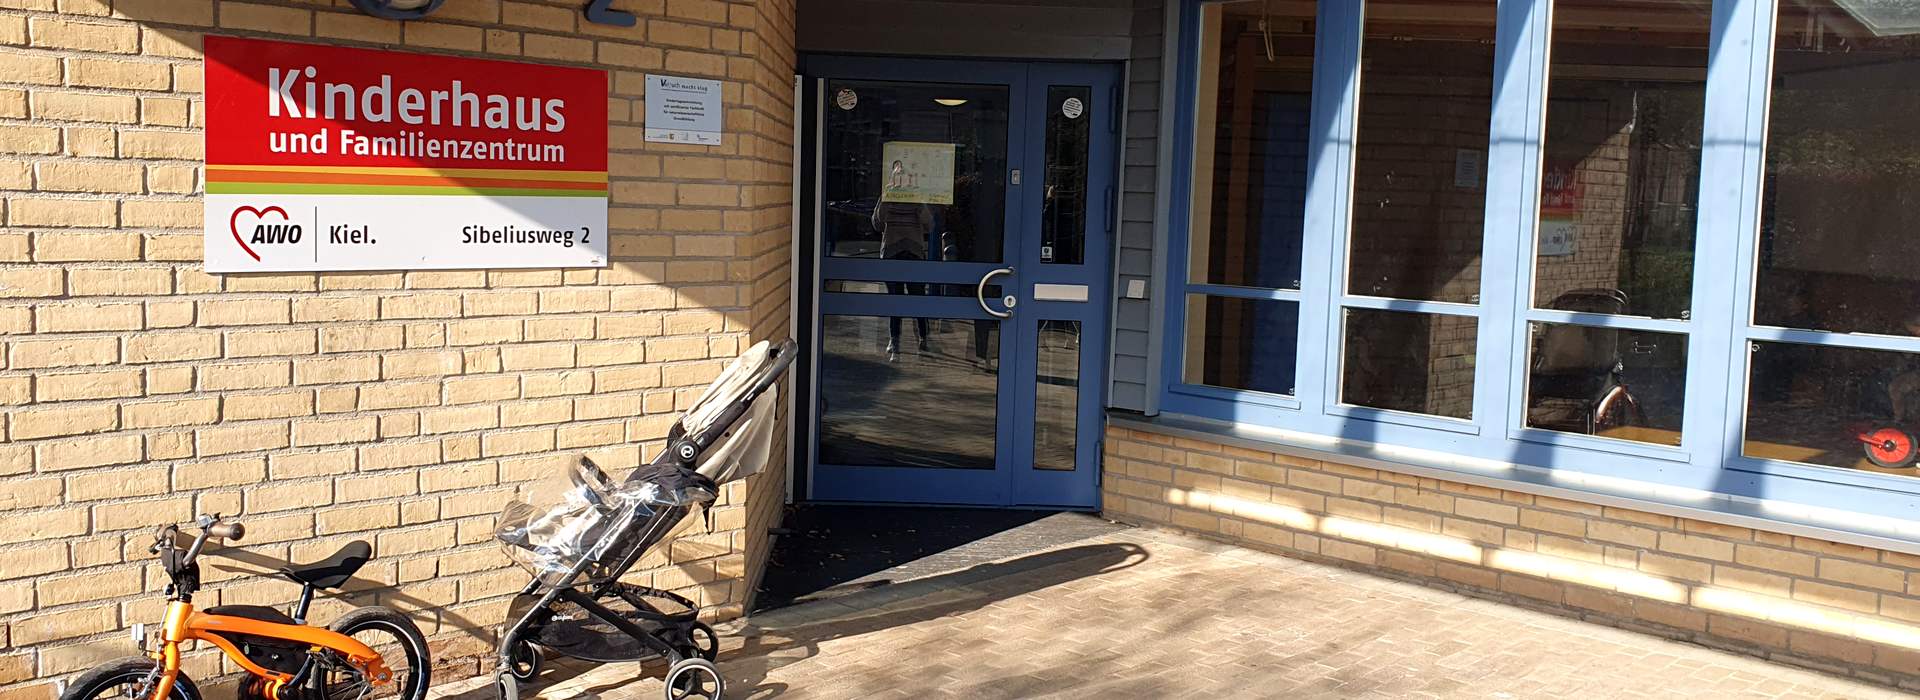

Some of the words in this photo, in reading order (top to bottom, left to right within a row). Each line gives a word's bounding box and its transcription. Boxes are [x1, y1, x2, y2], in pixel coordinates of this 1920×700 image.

[268, 66, 565, 133] Kinderhaus
[269, 128, 328, 154] und
[341, 129, 565, 162] Familienzentrum
[250, 224, 302, 244] AWO
[329, 225, 377, 244] Kiel.
[462, 225, 574, 248] Sibeliusweg
[581, 226, 590, 244] 2
